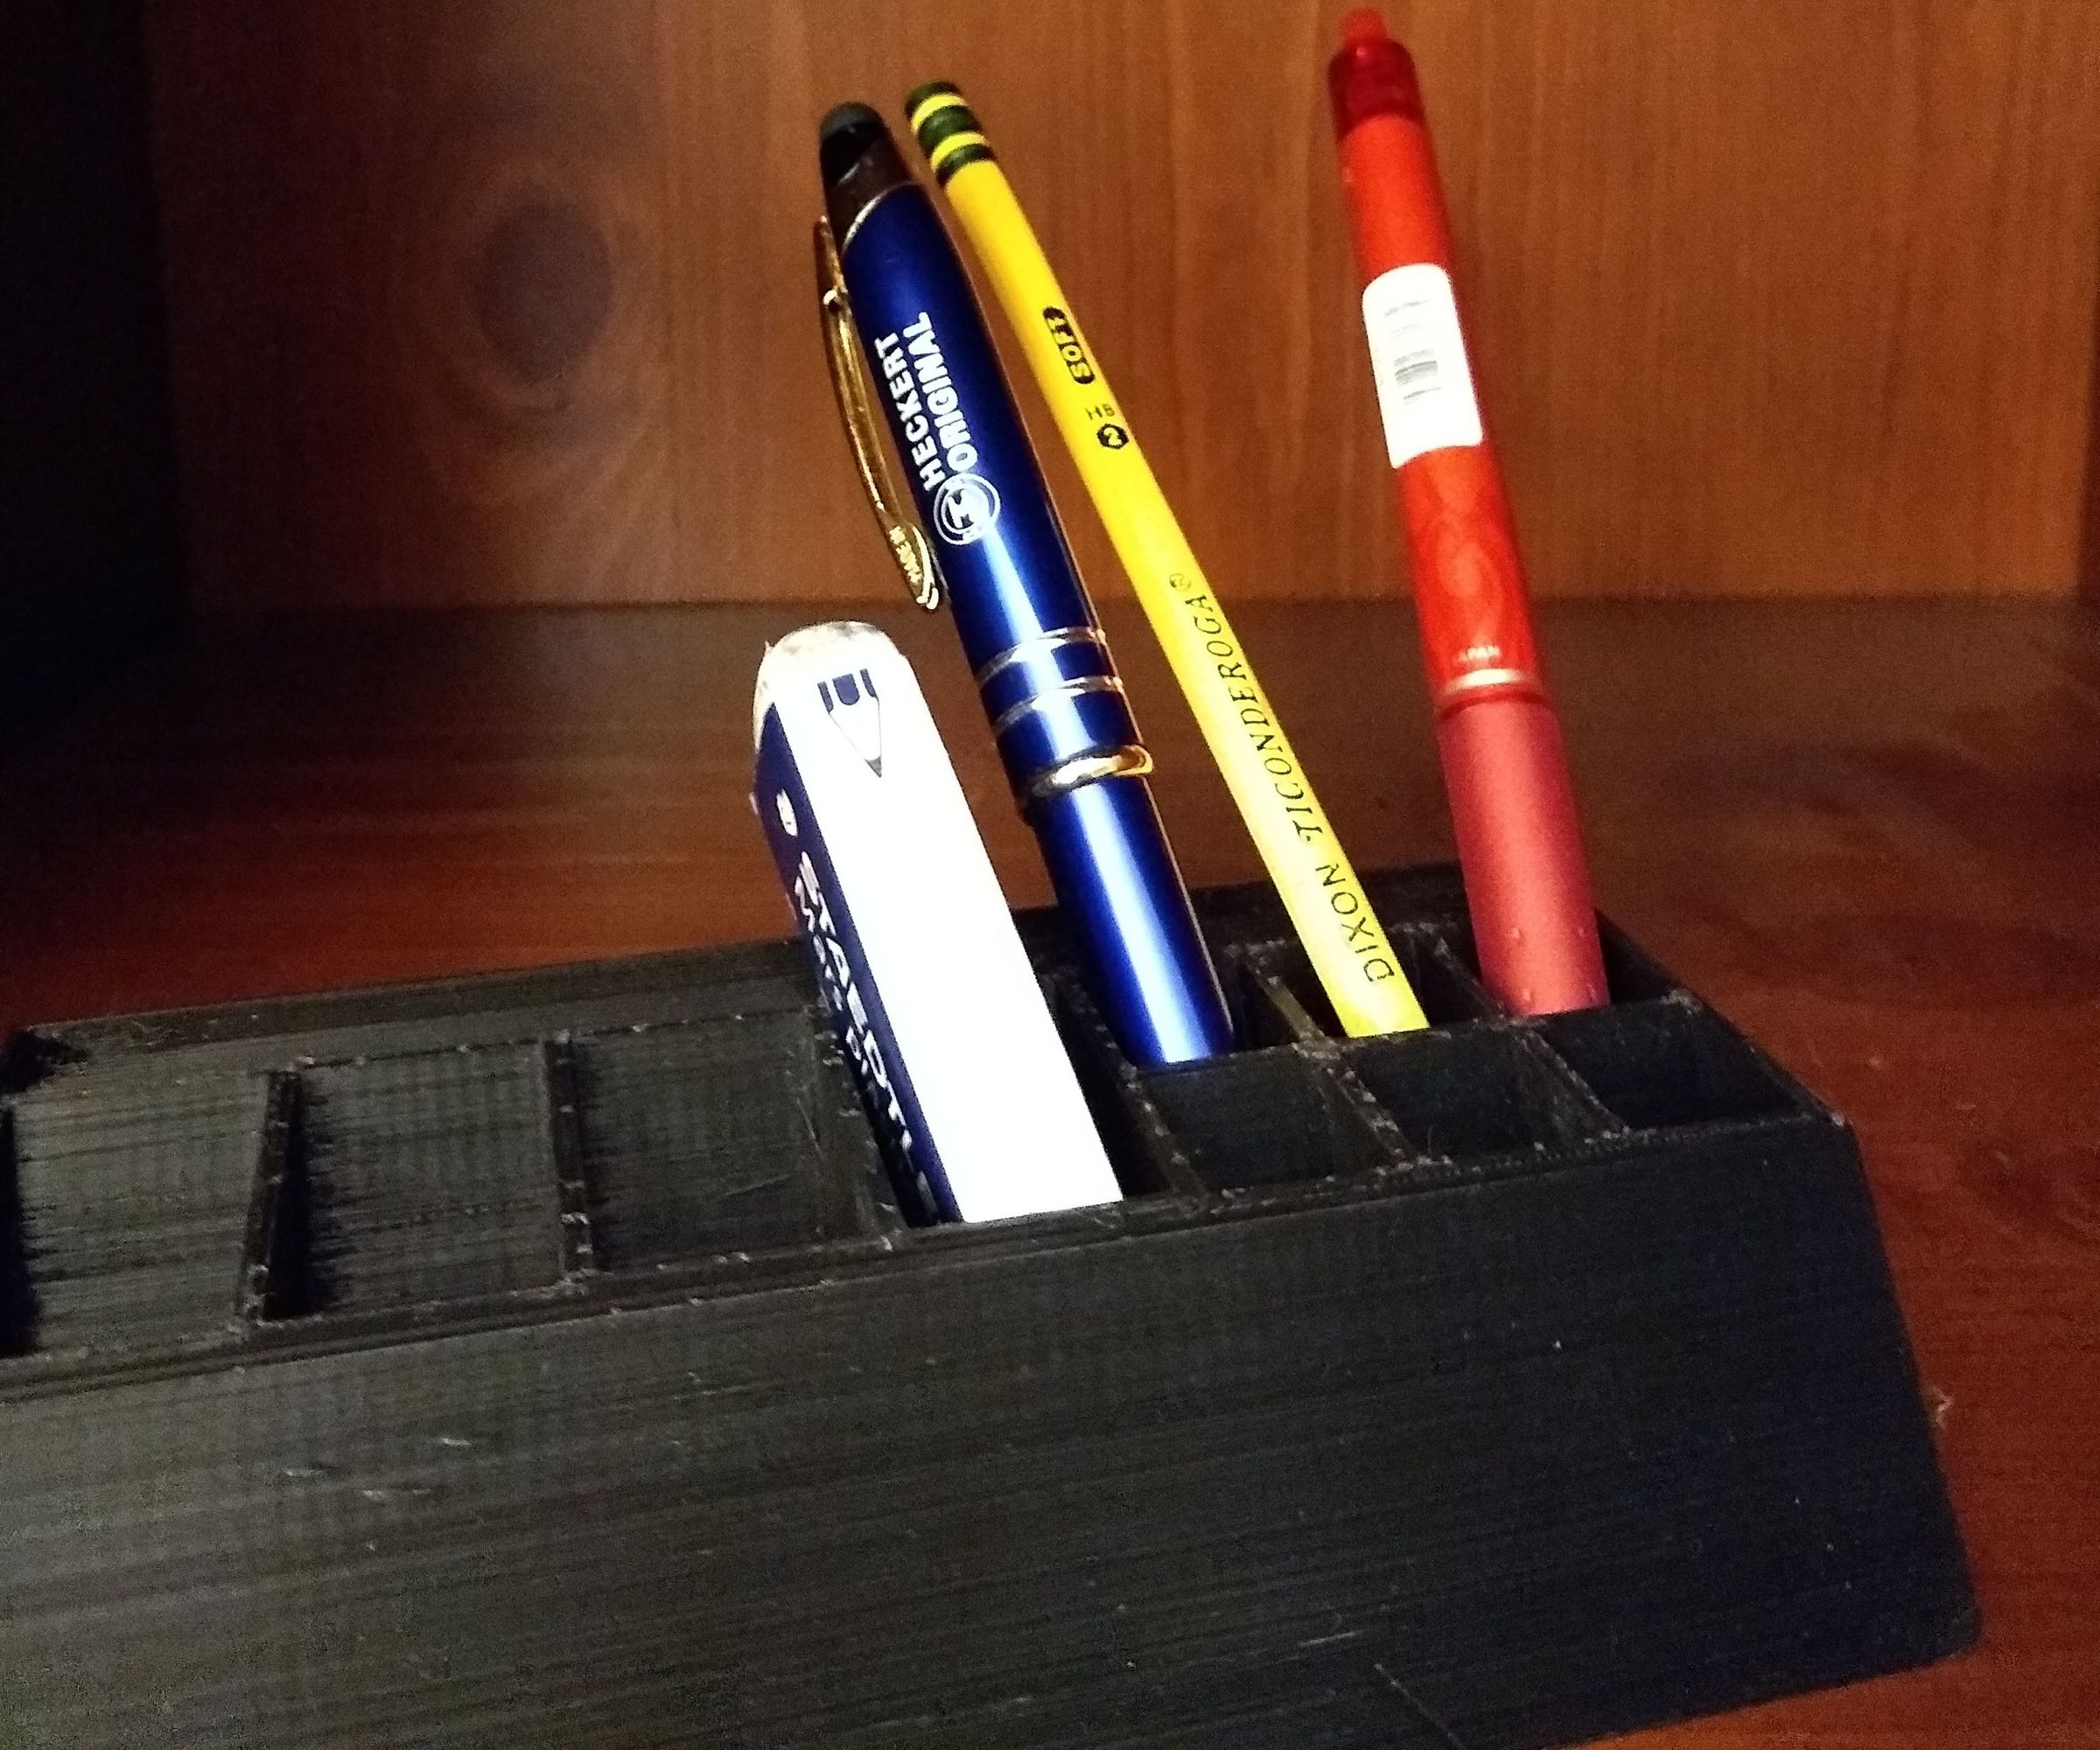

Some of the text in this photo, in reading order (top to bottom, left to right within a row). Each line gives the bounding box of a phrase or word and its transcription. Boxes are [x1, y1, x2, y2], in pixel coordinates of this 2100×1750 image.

[902, 311, 979, 473] ORIGINAL
[1046, 316, 1092, 378] SOFT
[874, 332, 946, 492] HECKERT
[1084, 402, 1116, 422] HB
[1314, 862, 1395, 984] DIXON
